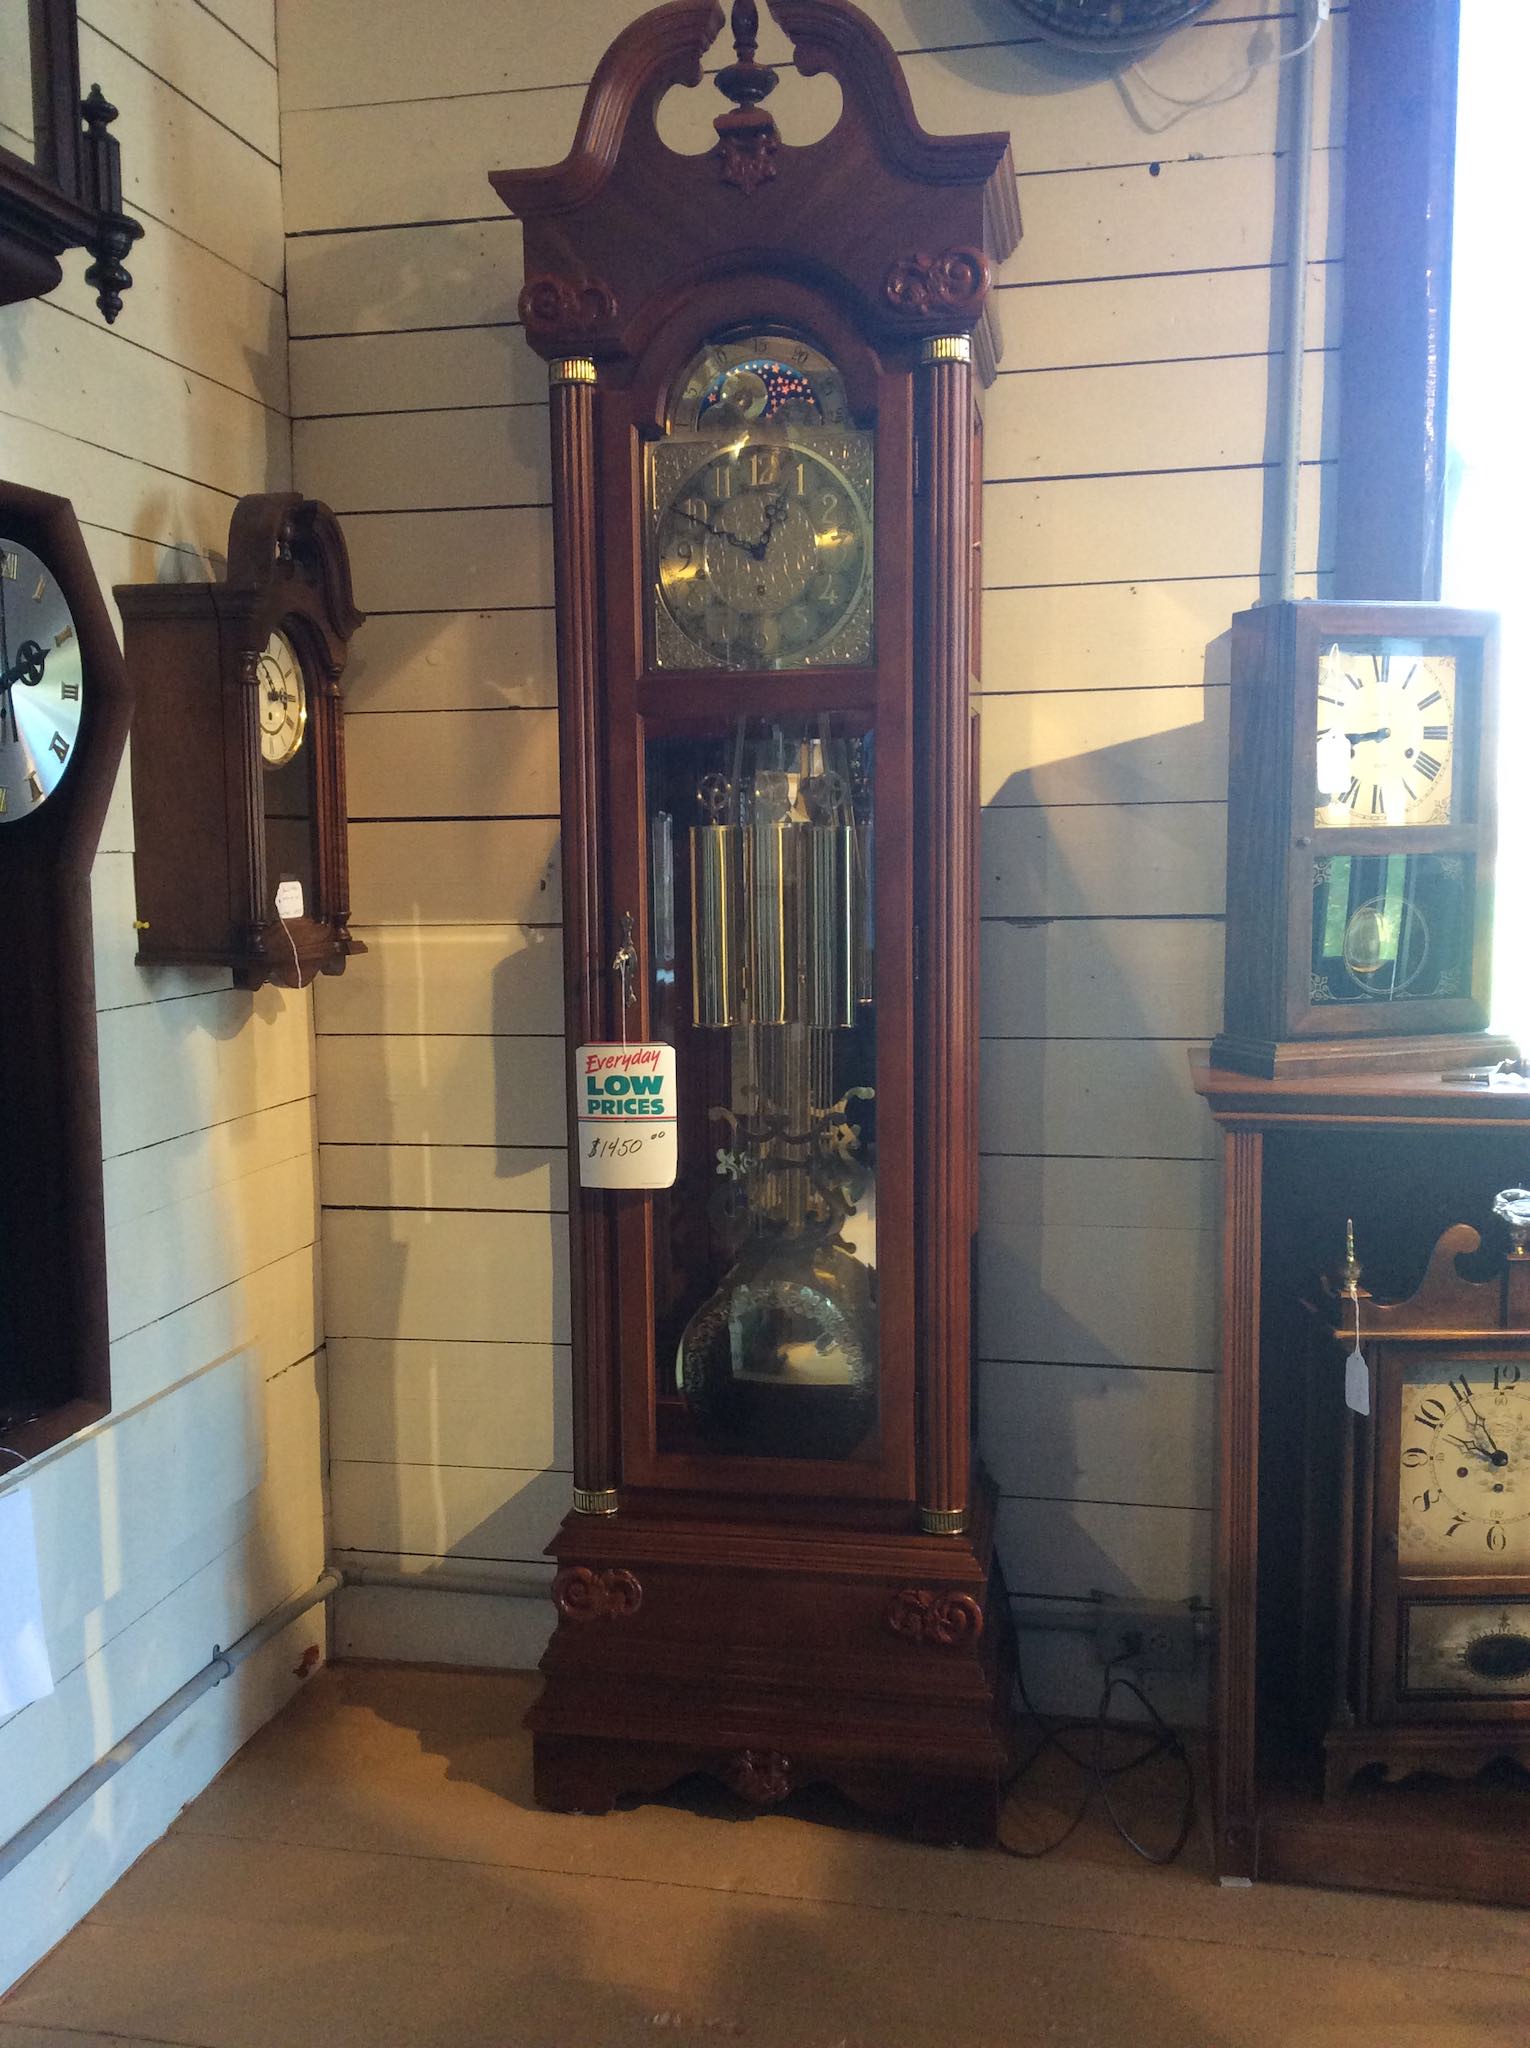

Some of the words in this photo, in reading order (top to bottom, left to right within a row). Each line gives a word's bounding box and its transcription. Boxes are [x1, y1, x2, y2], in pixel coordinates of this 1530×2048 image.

[61, 680, 79, 702] III
[1423, 725, 1449, 740] III
[585, 1048, 661, 1074] Everyday
[587, 1075, 664, 1096] LOW
[587, 1098, 665, 1115] PRICES
[588, 1137, 642, 1158] $1450
[1493, 1365, 1520, 1390] 12
[1415, 1398, 1446, 1430] 10
[1402, 1447, 1428, 1468] 9
[1444, 1515, 1470, 1537] 7
[1486, 1525, 1506, 1551] 6
